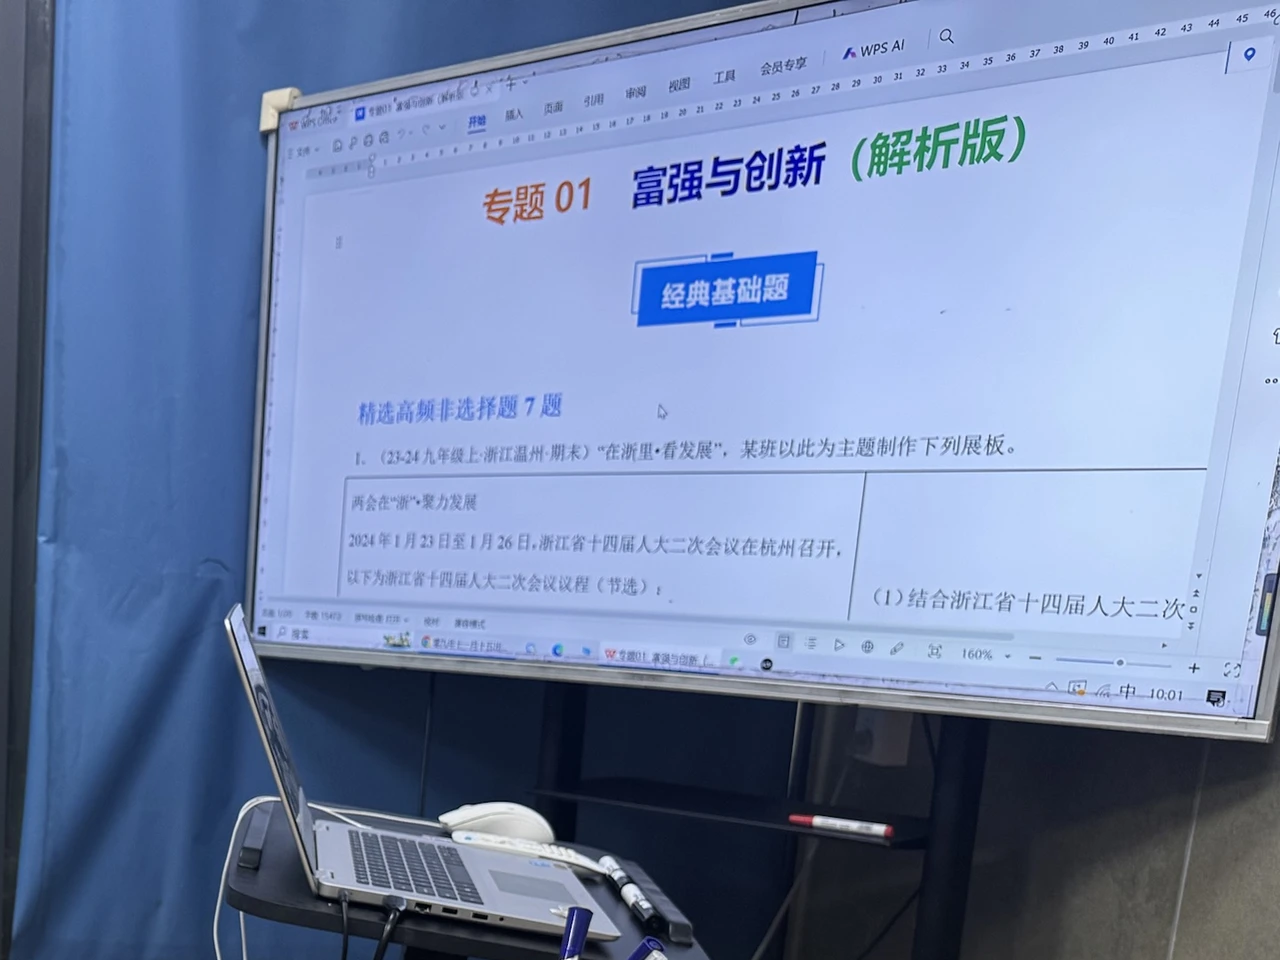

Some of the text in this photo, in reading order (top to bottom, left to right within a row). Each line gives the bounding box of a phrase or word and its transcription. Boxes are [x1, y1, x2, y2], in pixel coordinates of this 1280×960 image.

[468, 115, 487, 128] 开始
[505, 108, 524, 122] 插入
[543, 102, 563, 116] 页面
[584, 94, 604, 107] 引用
[625, 86, 647, 99] 审阅
[668, 77, 691, 93] 视图
[713, 69, 736, 85] 工具
[760, 56, 808, 77] 会员专享
[860, 42, 888, 57] WPS
[892, 39, 905, 51] AI
[678, 108, 687, 117] 20
[715, 102, 723, 110] 22
[733, 99, 742, 108] 23
[752, 96, 761, 104] 24
[772, 92, 781, 101] 25
[791, 89, 800, 98] 26
[811, 86, 820, 94] 27
[831, 83, 840, 91] 28
[852, 79, 861, 88] 29
[873, 75, 882, 84] 30
[894, 72, 903, 81] 31
[915, 68, 925, 77] 32
[937, 65, 947, 74] 33
[959, 61, 970, 70] 34
[983, 57, 993, 66] 35
[1006, 53, 1016, 62] 36
[1029, 49, 1041, 58] 37
[1053, 45, 1064, 54] 38
[1078, 40, 1089, 50] 39
[1103, 36, 1115, 46] 40
[1128, 32, 1139, 41] 41
[1154, 27, 1167, 37] 42
[1181, 23, 1193, 33] 43
[1208, 18, 1220, 28] 44
[1236, 13, 1248, 23] 45
[1264, 8, 1276, 19] 46
[483, 115, 1027, 226] 专题 01 富强与创新 （解析版）
[661, 273, 790, 310] 经典基础题
[962, 647, 993, 660] 160%
[1119, 682, 1136, 700] 中
[1150, 687, 1184, 701] 10:01
